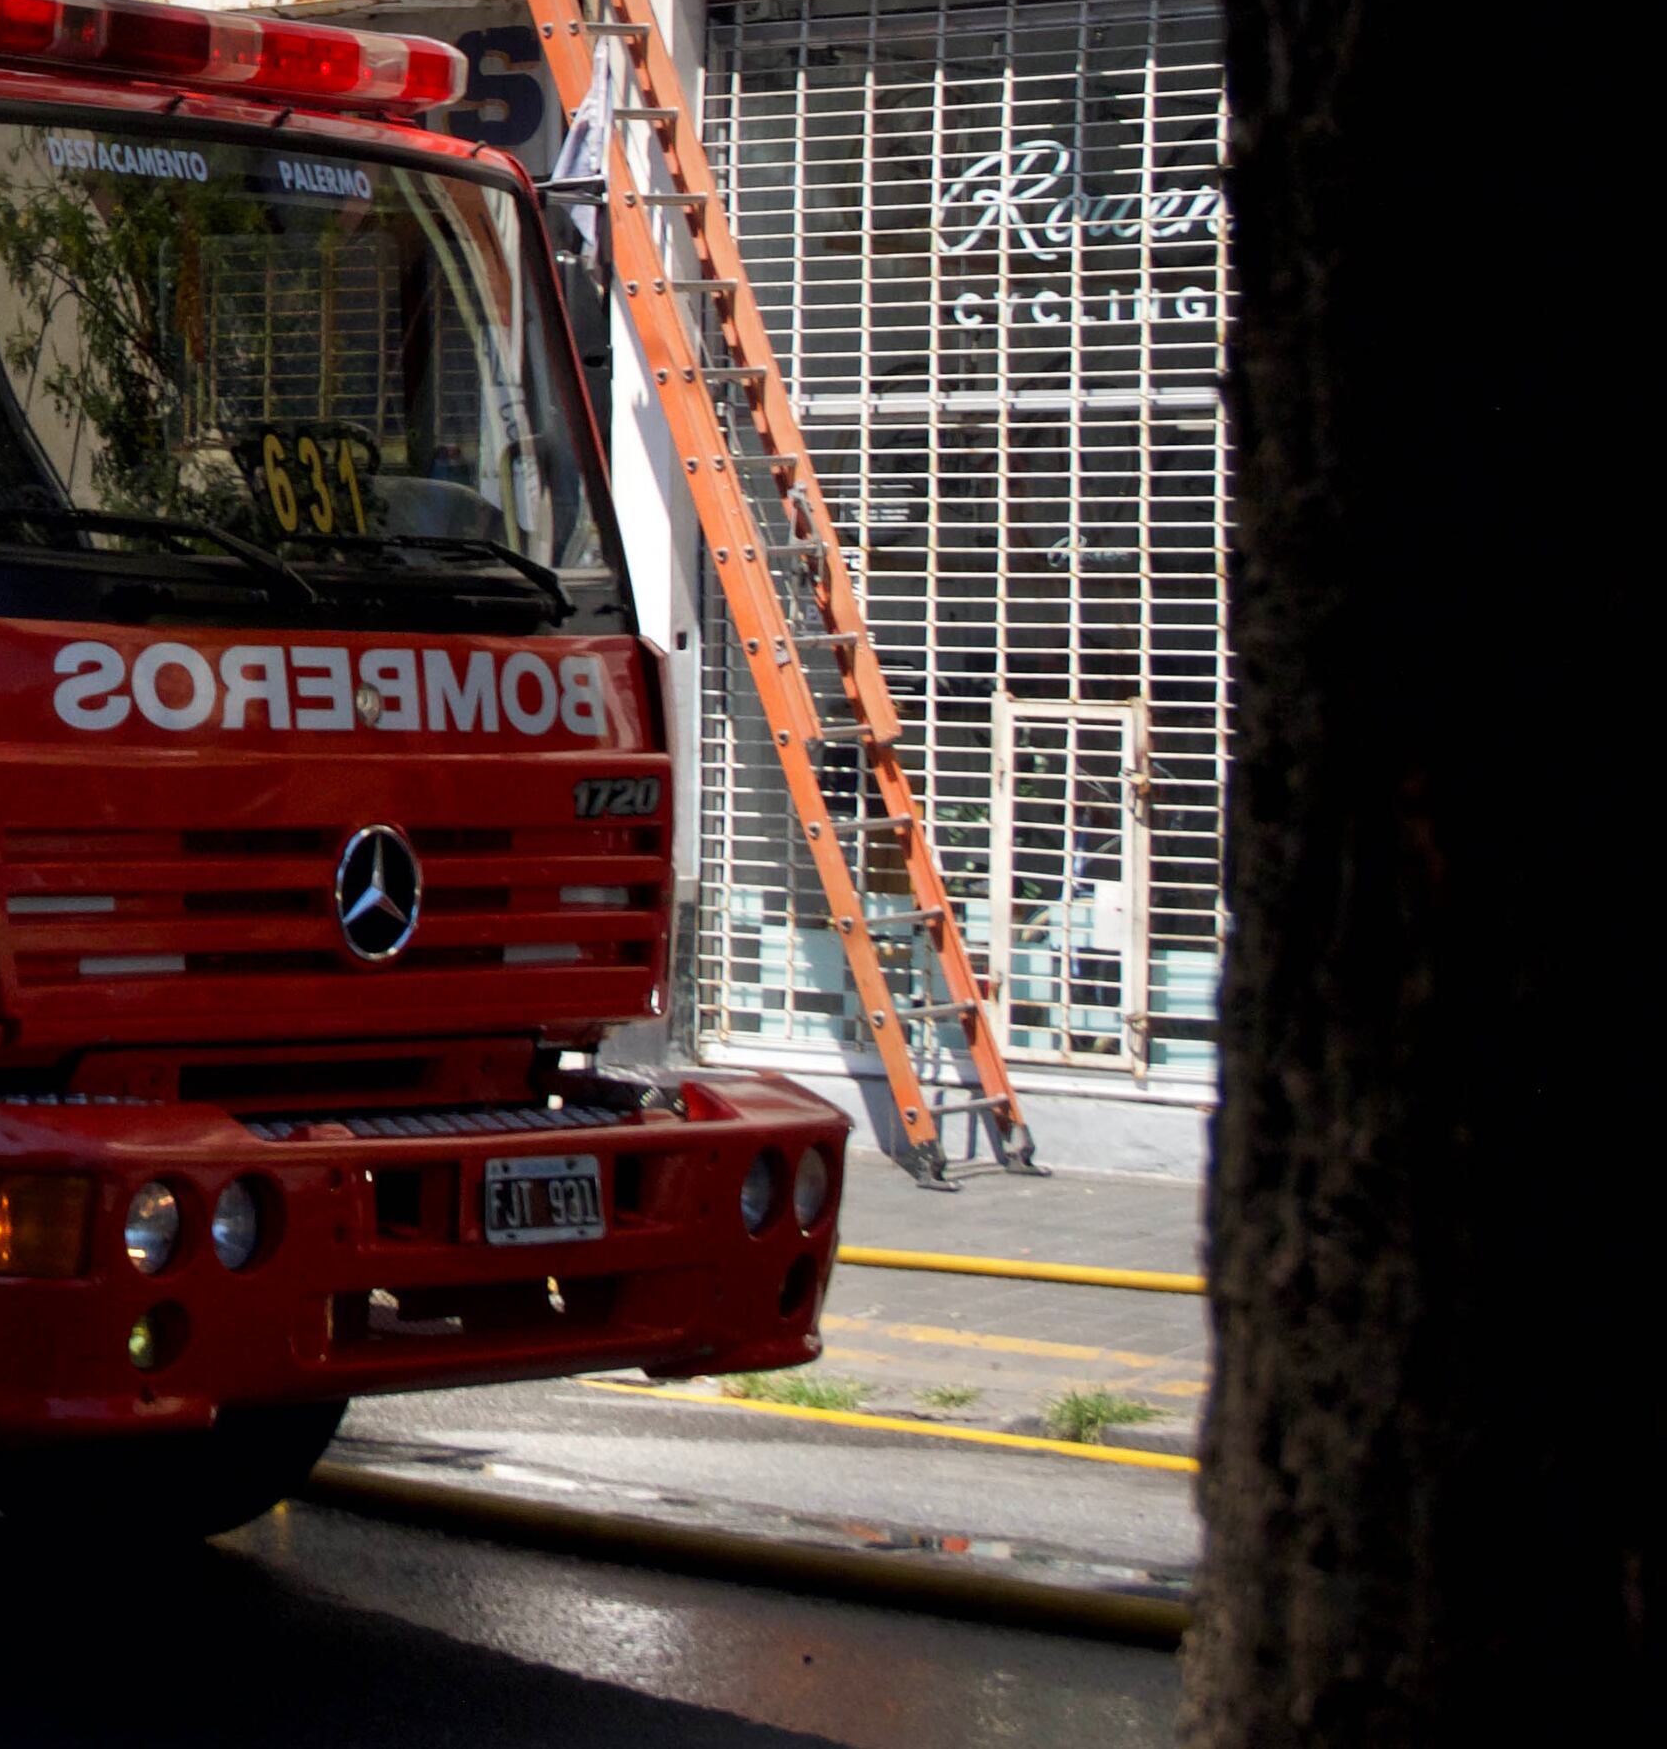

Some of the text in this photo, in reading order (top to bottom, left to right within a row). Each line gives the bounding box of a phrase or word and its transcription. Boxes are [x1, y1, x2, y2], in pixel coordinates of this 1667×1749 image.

[46, 135, 372, 199] DESTACAMENTO PALERMO
[263, 433, 367, 535] 631
[573, 777, 661, 818] 1720
[548, 1177, 600, 1227] 931
